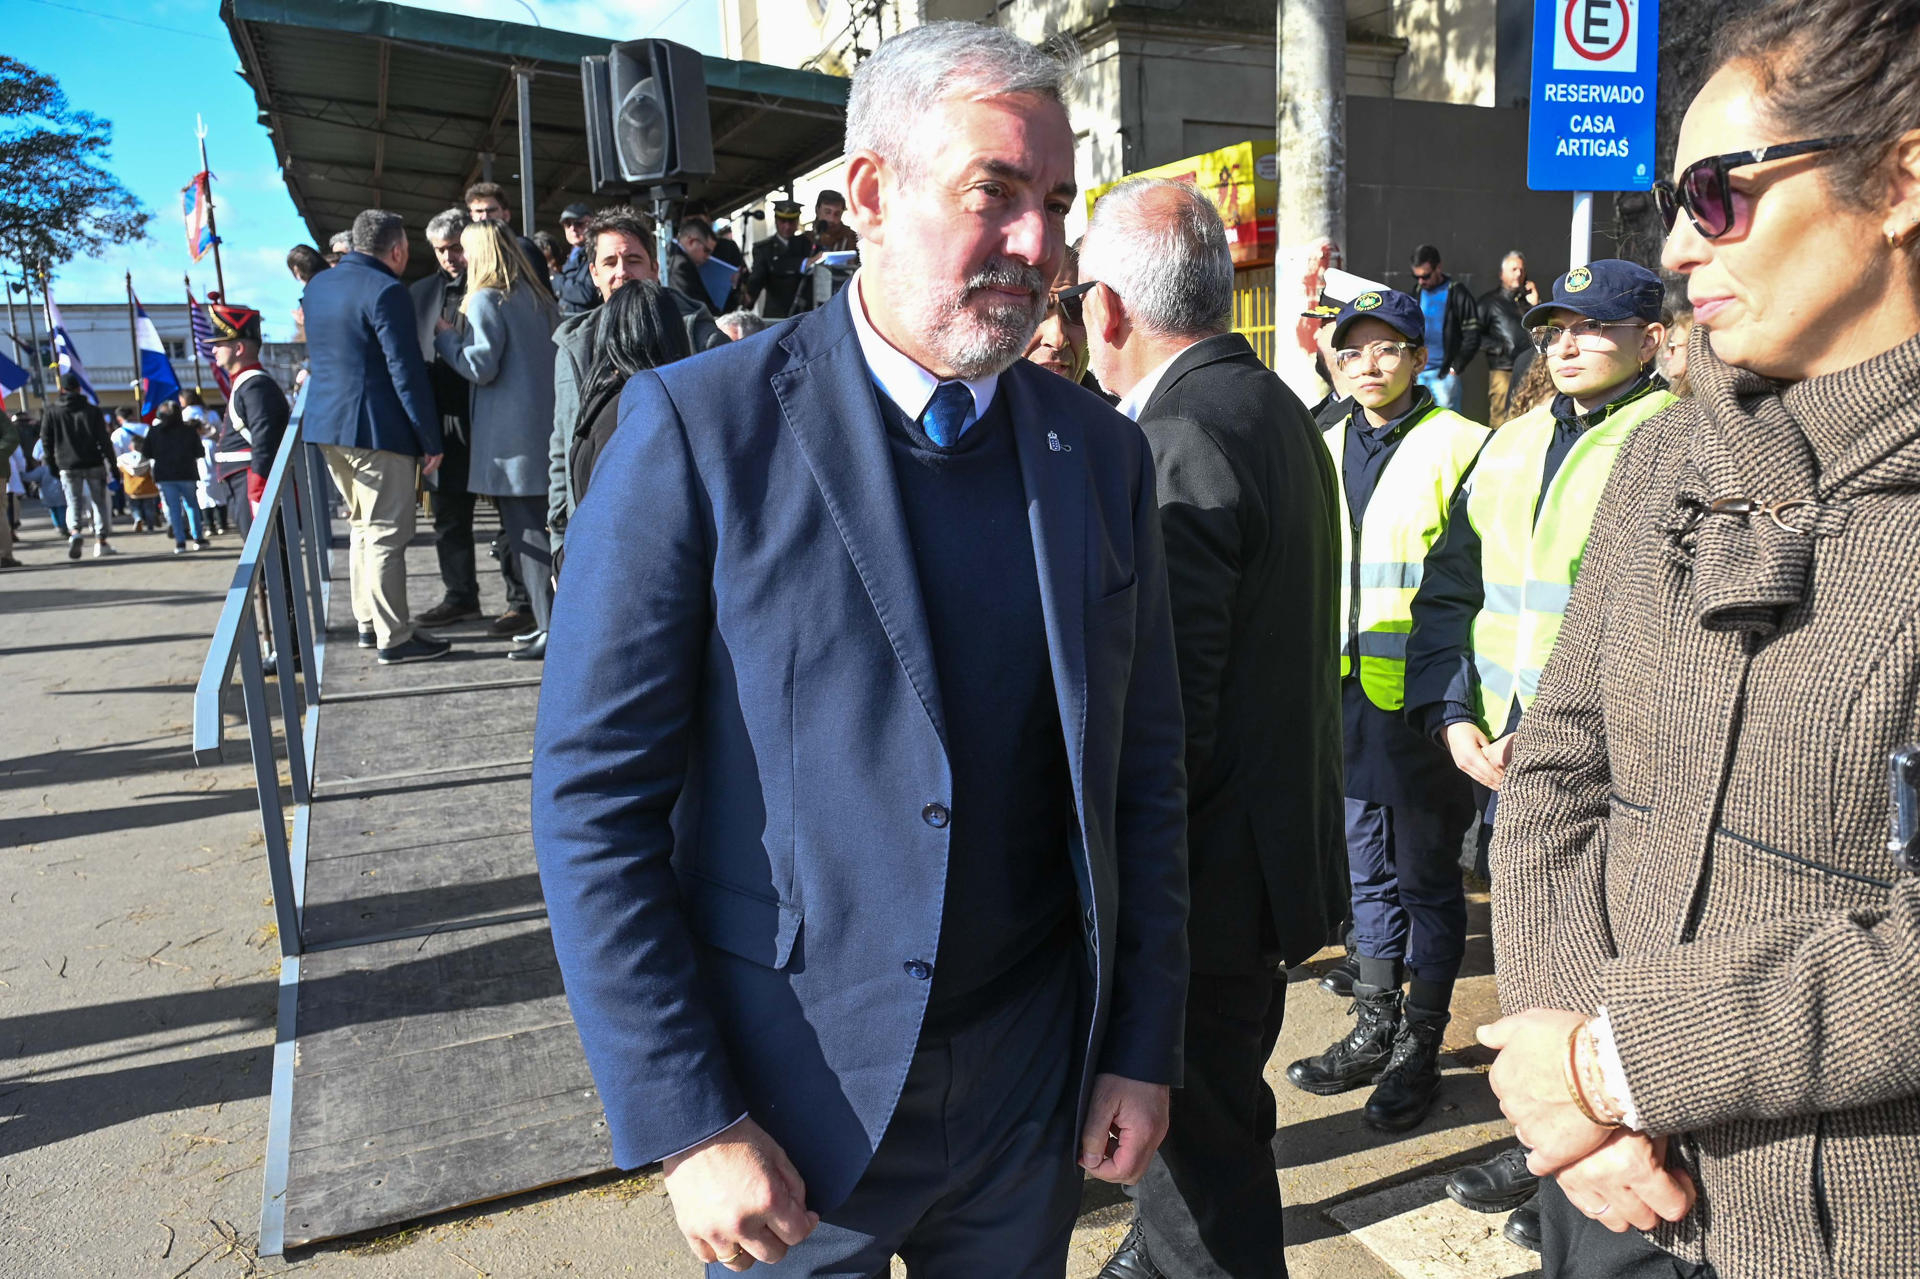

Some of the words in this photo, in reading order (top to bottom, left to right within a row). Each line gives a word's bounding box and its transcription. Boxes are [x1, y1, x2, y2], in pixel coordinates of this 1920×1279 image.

[1583, 0, 1611, 45] E
[1544, 83, 1645, 104] RESERVADO
[1570, 114, 1616, 133] CASA
[1556, 138, 1629, 158] ARTIGAS
